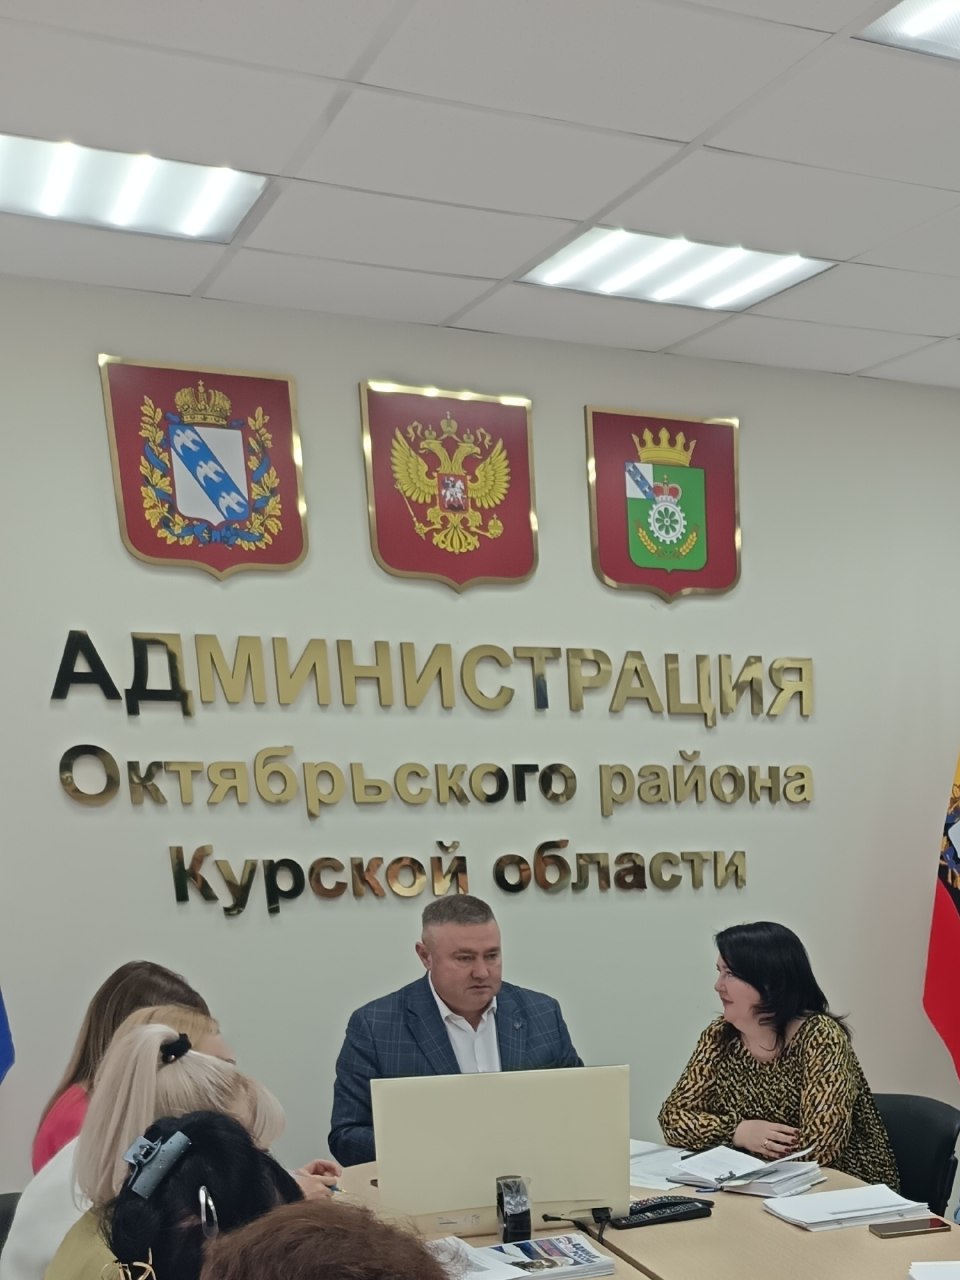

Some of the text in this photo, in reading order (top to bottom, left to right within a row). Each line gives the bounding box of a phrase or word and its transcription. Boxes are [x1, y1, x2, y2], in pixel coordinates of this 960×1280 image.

[51, 629, 815, 727] АДМИНИСТРАЦИЯ
[58, 743, 815, 818] Октябрьского района
[169, 839, 747, 916] Курской области
